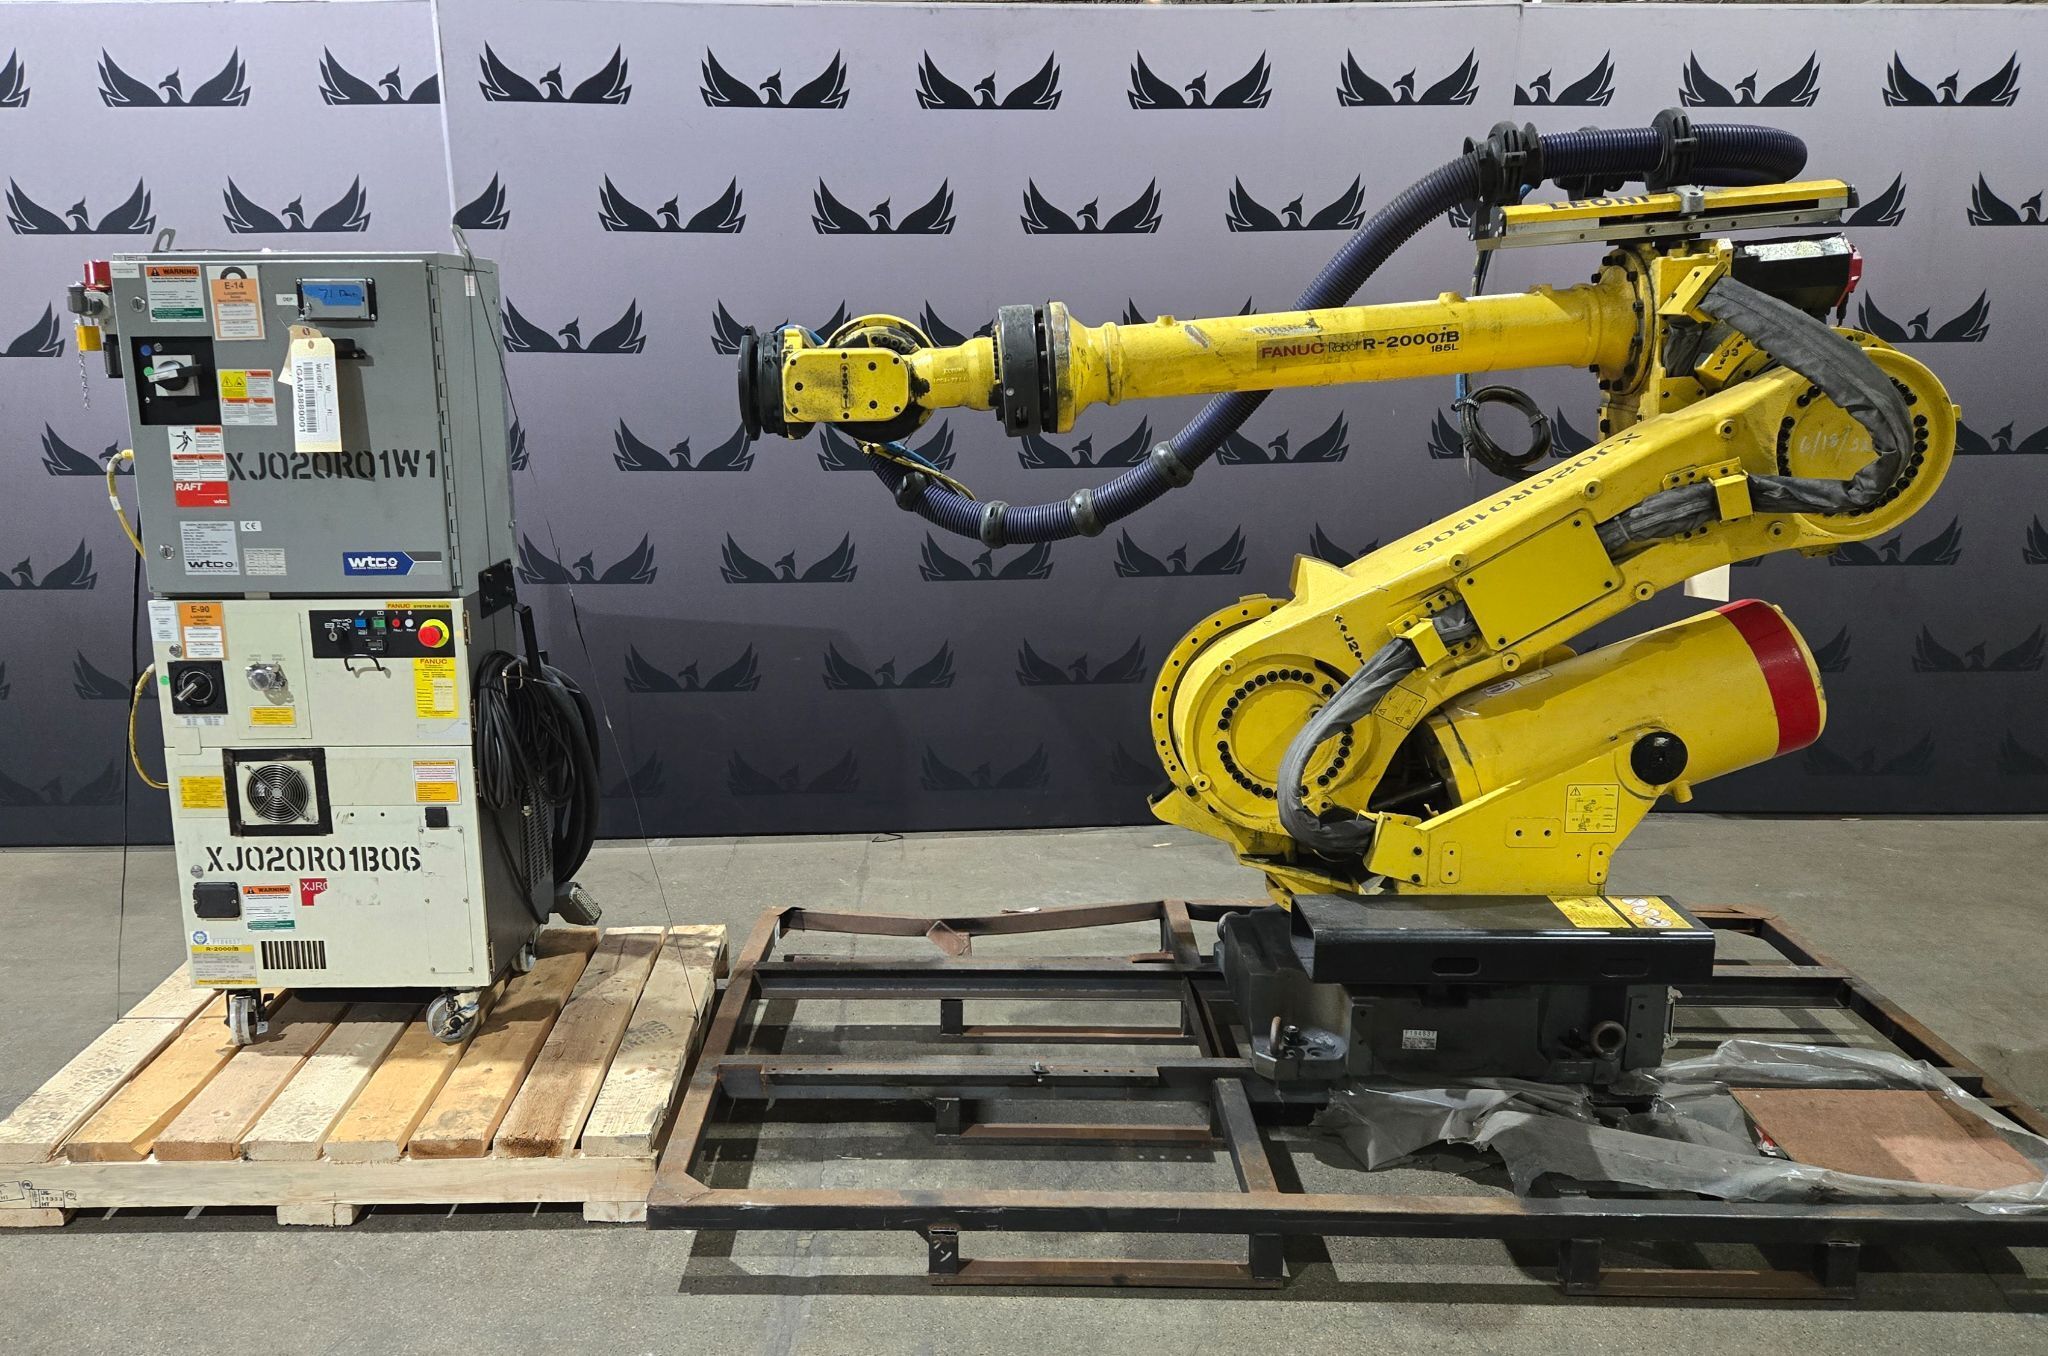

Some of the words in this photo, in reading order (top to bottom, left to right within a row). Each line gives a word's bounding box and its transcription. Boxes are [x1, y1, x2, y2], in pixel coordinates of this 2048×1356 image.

[1549, 194, 1650, 210] LEONI
[162, 268, 198, 276] WARNING
[224, 281, 245, 290] E-14
[1261, 343, 1324, 359] FANUC
[1328, 340, 1363, 353] Robot
[1362, 326, 1460, 350] R-2000iB
[1430, 343, 1459, 353] 185L
[295, 365, 307, 433] IGAM3880001
[226, 449, 437, 481] XJ020R01W1
[175, 482, 203, 491] RAFT
[191, 605, 210, 613] E-90
[206, 846, 422, 872] XJ020R01B06
